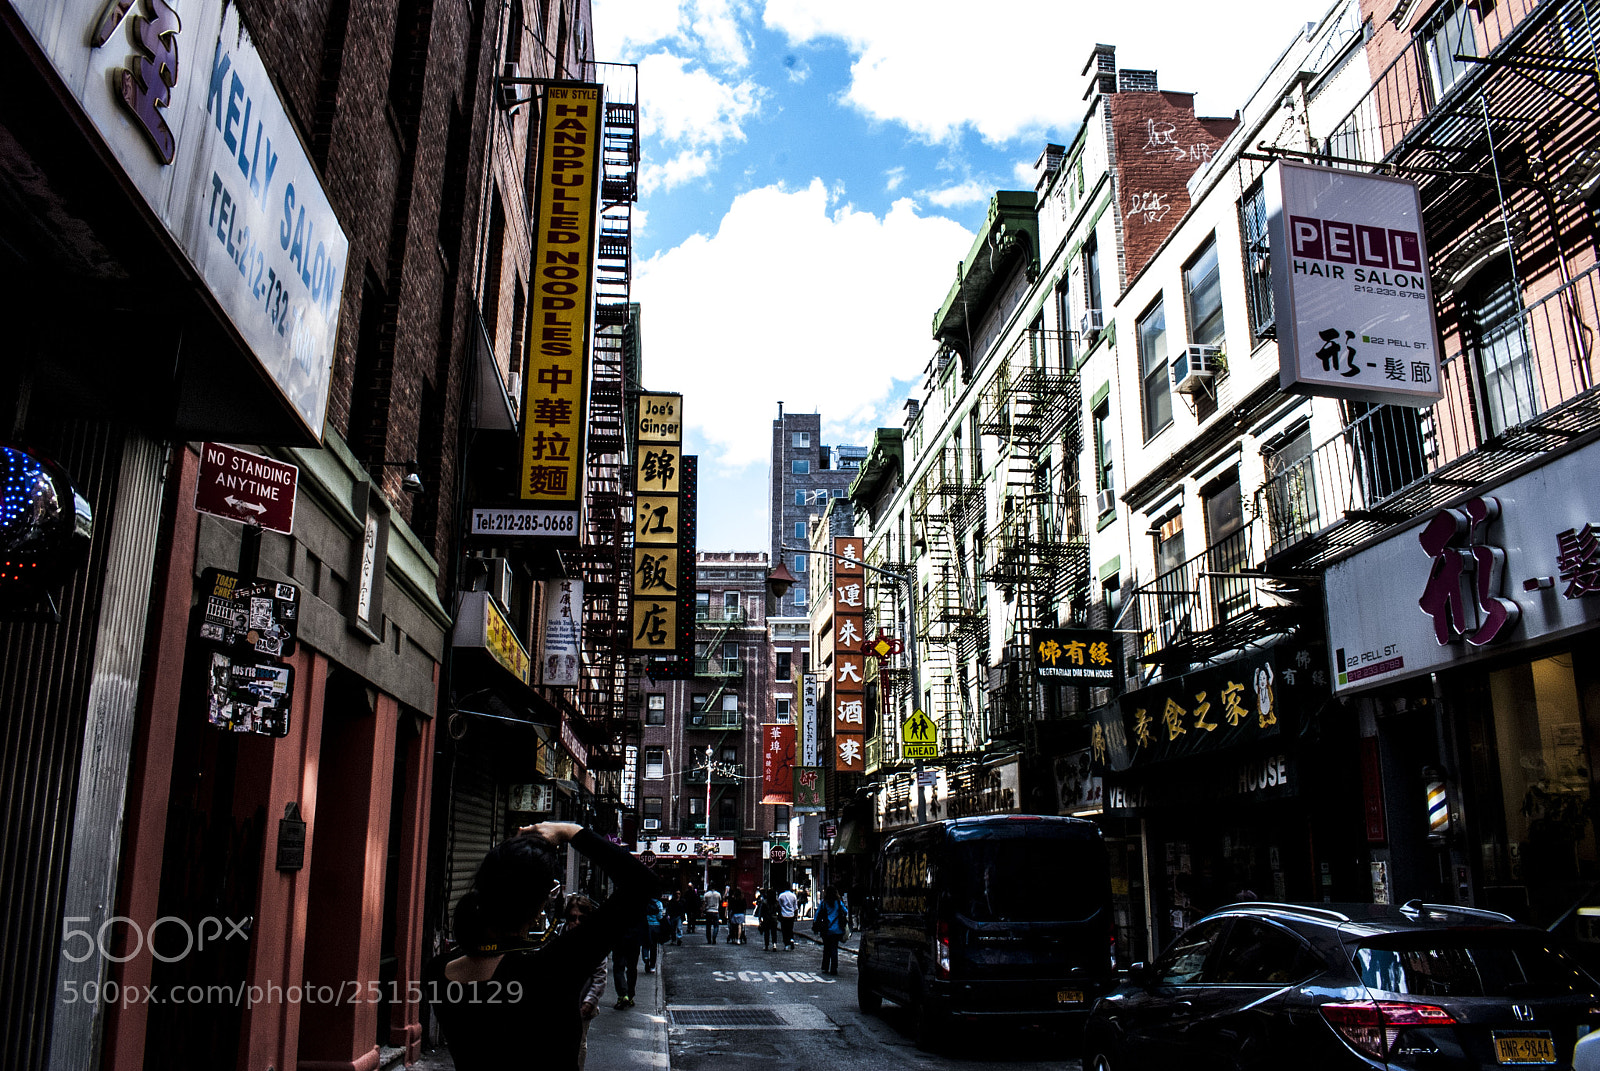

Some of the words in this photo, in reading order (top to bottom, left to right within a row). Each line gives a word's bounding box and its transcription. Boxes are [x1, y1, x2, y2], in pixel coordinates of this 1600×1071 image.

[549, 87, 569, 100] NEW
[572, 88, 597, 101] STYLE
[207, 41, 278, 213] KELLY
[280, 182, 338, 322] SALON
[546, 103, 588, 244] HANDPULLED
[1294, 221, 1417, 268] PELL
[1293, 260, 1345, 281] HAIR
[1353, 268, 1425, 291] SALON
[540, 251, 581, 357] NOODLES
[1354, 284, 1426, 300] 212.233.6789
[1370, 336, 1385, 345] 22
[1387, 338, 1412, 349] PELL
[1414, 341, 1429, 350] ST.
[645, 400, 674, 416] Joe's
[529, 364, 573, 496] 中華拉麵
[640, 417, 679, 437] Ginger
[207, 448, 226, 467] NO
[231, 456, 291, 485] STANDING
[215, 472, 280, 501] ANYTIME
[475, 513, 574, 534] Tel:212-285-0668
[636, 447, 677, 645] 錦江飯店
[215, 573, 239, 590] TOAST
[837, 543, 863, 766] 喜運來大酒家
[1038, 639, 1113, 668] 佛有緣
[1346, 654, 1360, 668] 22
[1360, 650, 1382, 665] PELL
[1384, 644, 1399, 658] ST.
[1038, 667, 1072, 678] VEGETARIAN
[1095, 669, 1114, 679] HOUSE
[1348, 660, 1401, 682] 212.233.6789
[1132, 680, 1250, 749] 素食之家
[907, 746, 936, 756] AHEAD
[1238, 755, 1288, 794] HOUSE
[640, 854, 657, 863] STOP
[771, 850, 786, 858] STOP
[1500, 1040, 1520, 1058] HNR
[1523, 1040, 1550, 1058] 9844
